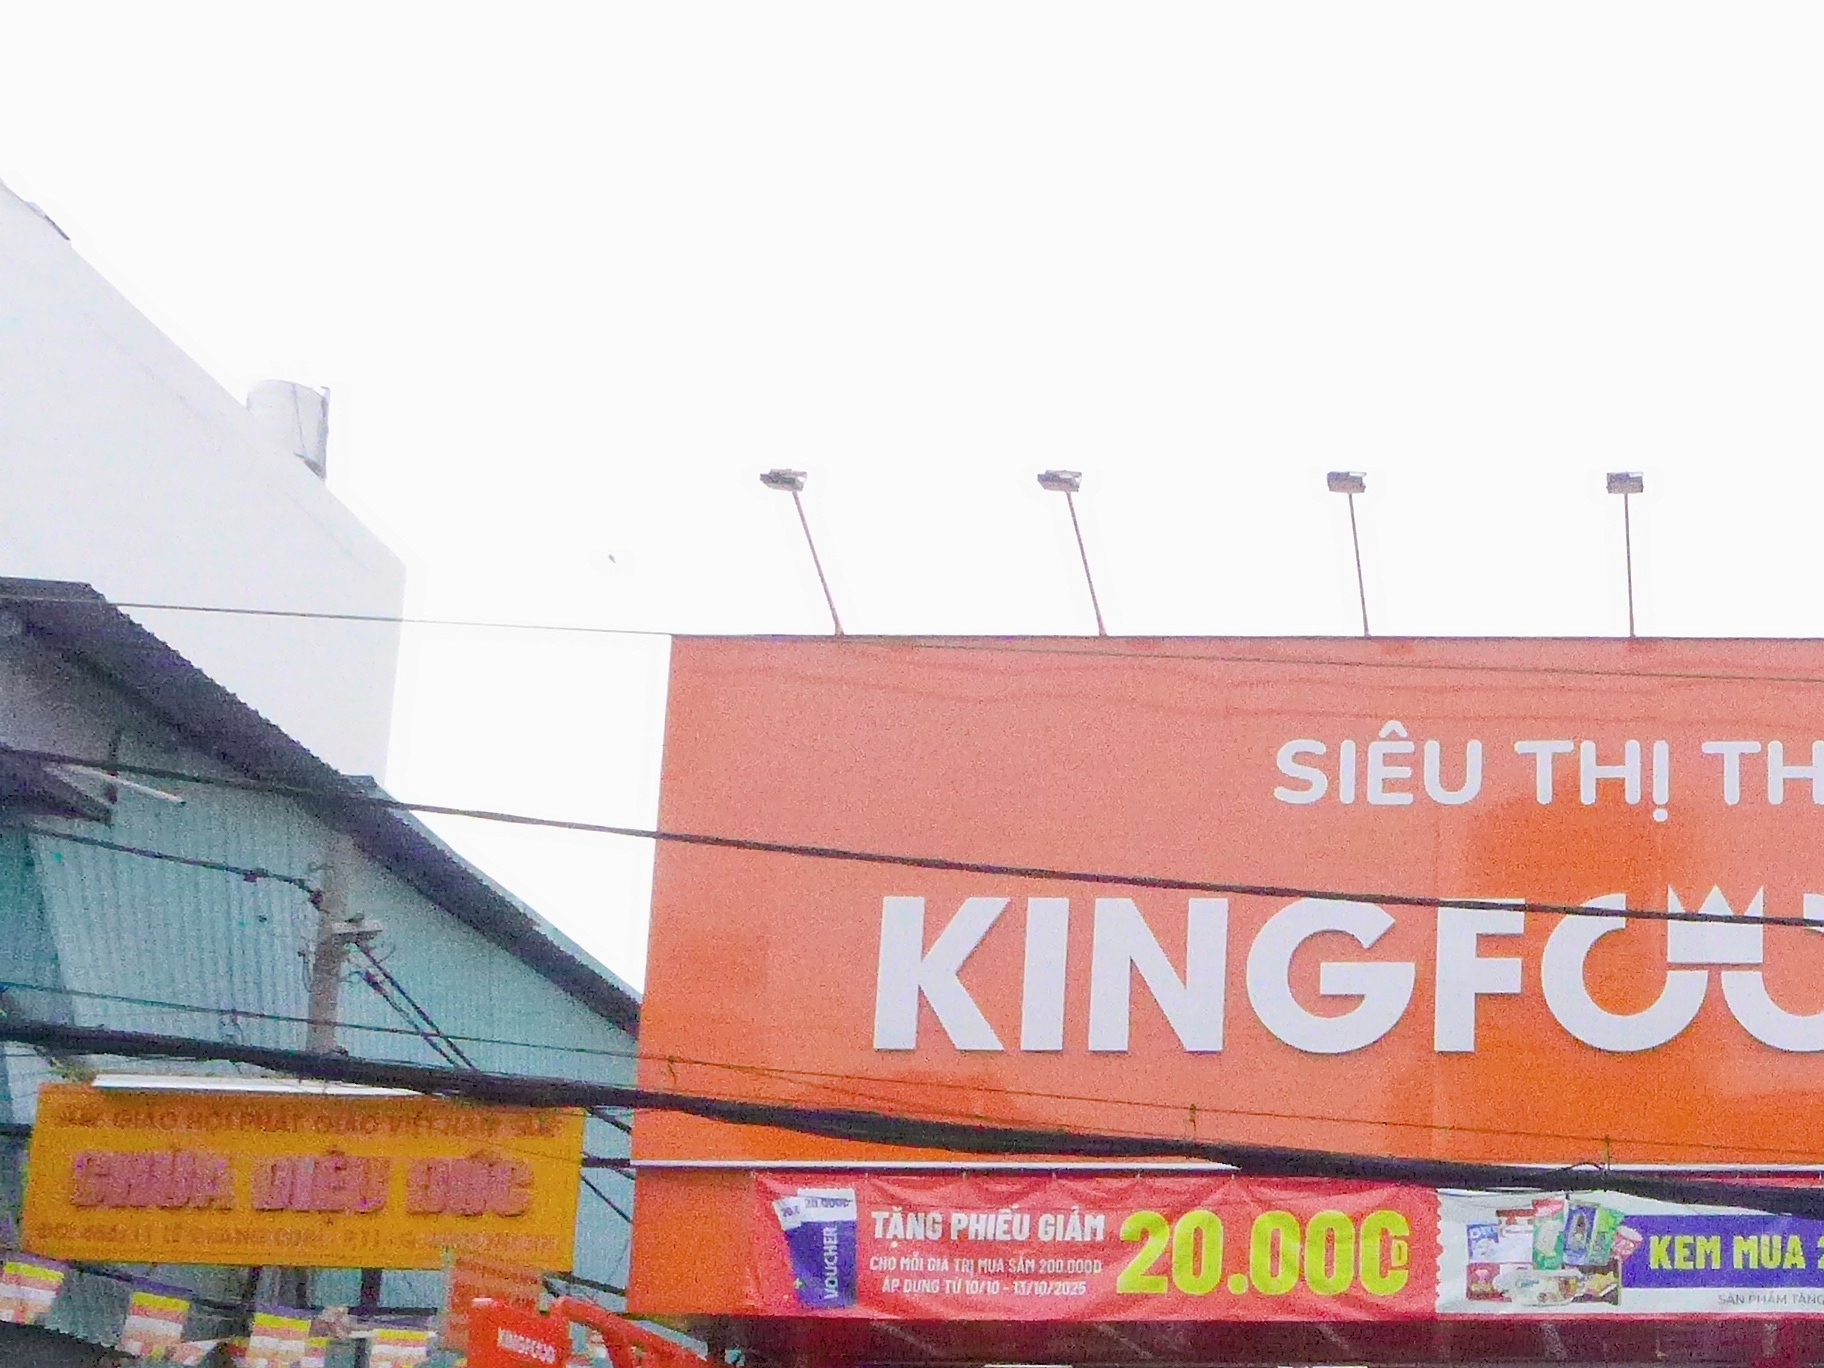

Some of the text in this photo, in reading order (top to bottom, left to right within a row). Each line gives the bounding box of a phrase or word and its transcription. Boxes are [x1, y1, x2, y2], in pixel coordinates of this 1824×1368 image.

[1273, 719, 1483, 806] SIÊU
[1514, 738, 1670, 823] THỊ
[871, 1203, 1106, 1249] TẶNG PHIẾU GIẢM
[1648, 1235, 1722, 1271] KEM
[1732, 1235, 1807, 1271] MUA
[822, 1226, 840, 1301] VOUCHER
